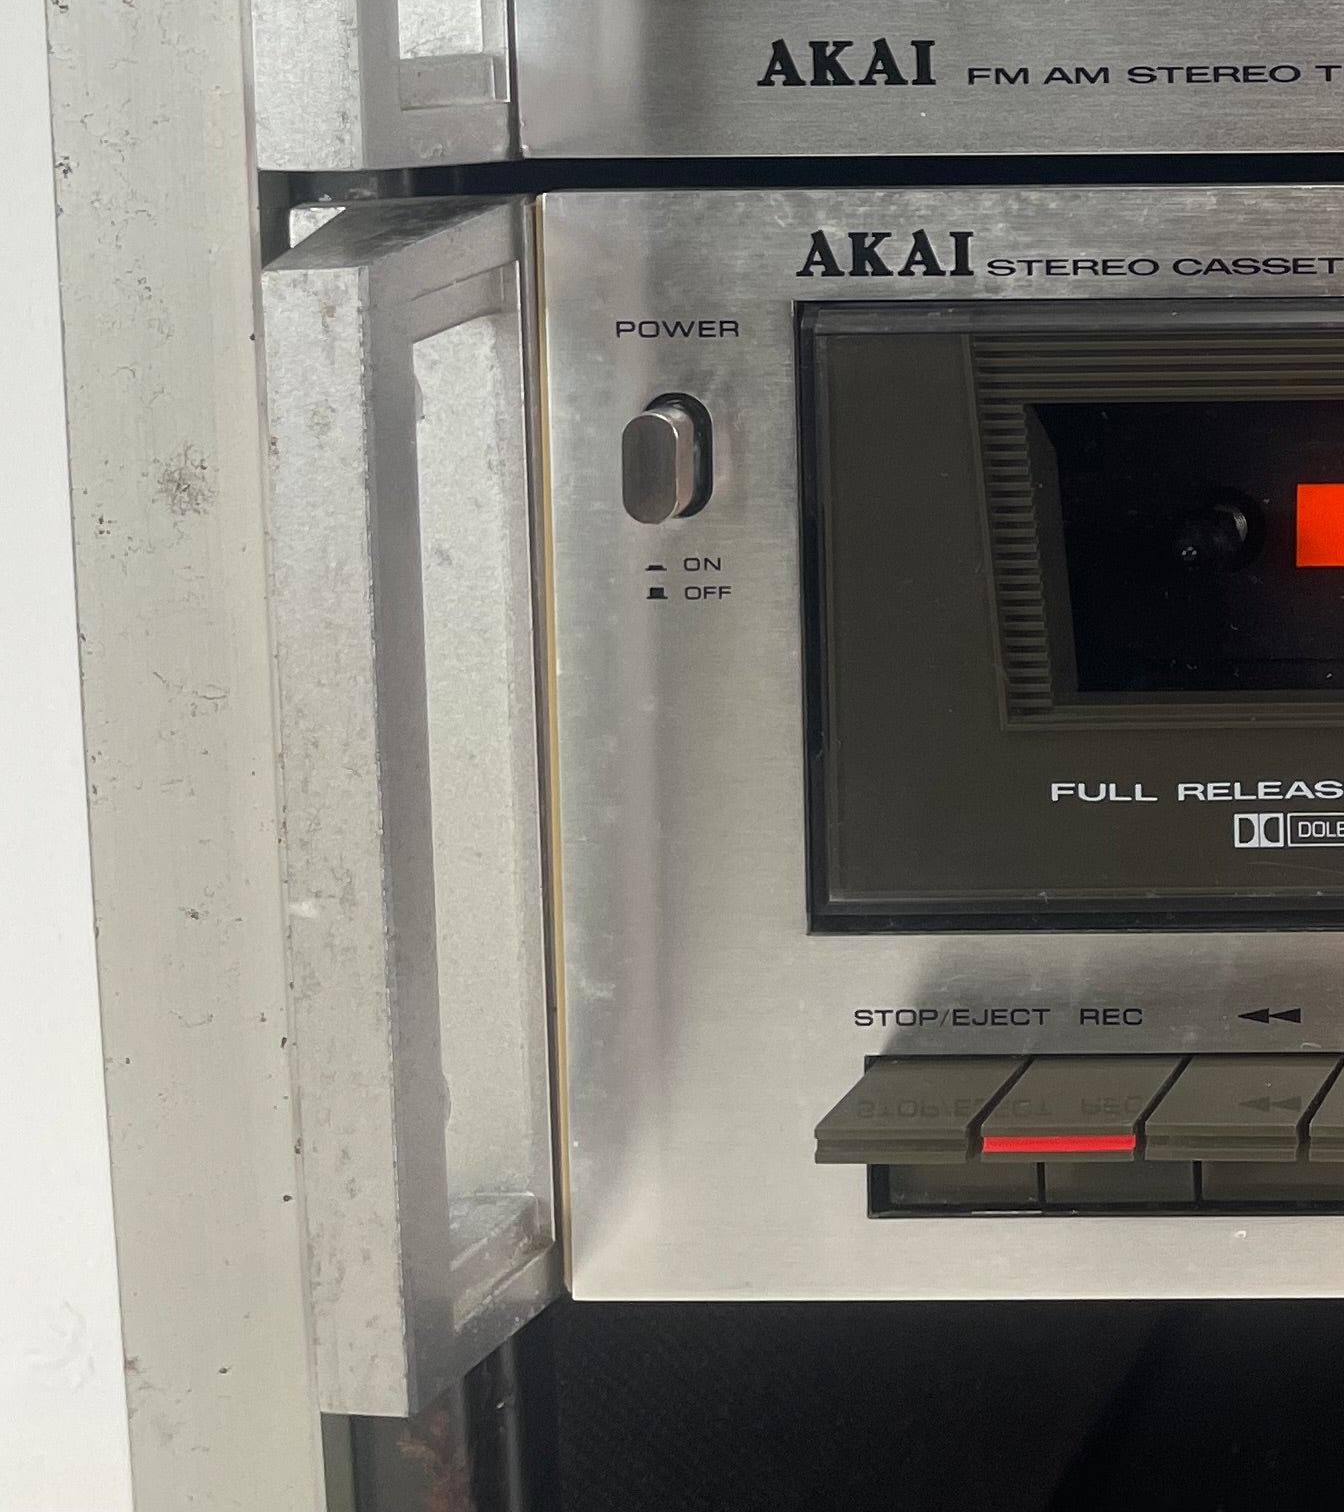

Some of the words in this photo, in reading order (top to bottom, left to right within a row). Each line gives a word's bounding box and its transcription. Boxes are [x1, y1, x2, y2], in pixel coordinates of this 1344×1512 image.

[756, 37, 937, 87] AKAI
[967, 67, 1030, 86] FM
[1043, 66, 1110, 85] AM
[1127, 64, 1302, 84] STEREO
[795, 228, 975, 278] AKAI
[986, 258, 1161, 277] STEREO
[615, 319, 740, 339] POWER
[683, 557, 722, 572] ON
[684, 585, 732, 601] OFF
[1051, 782, 1158, 802] FULL
[853, 1007, 1051, 1028] STOP/EJECT
[1079, 1007, 1143, 1026] REC
